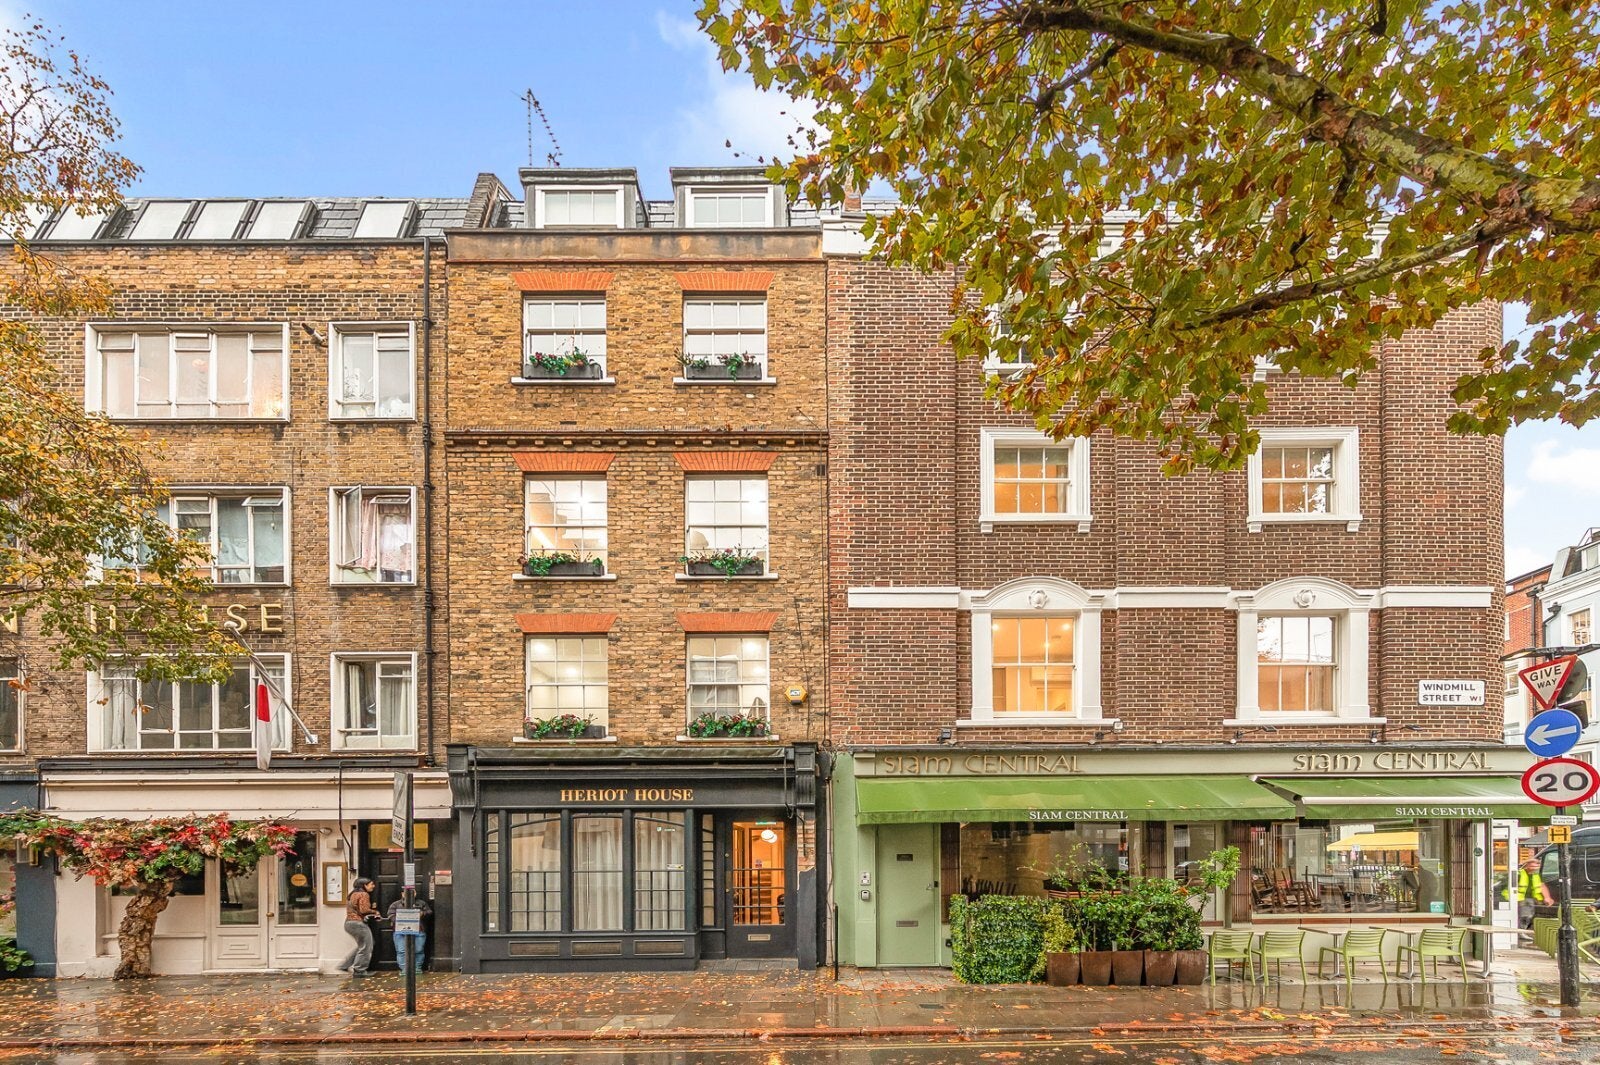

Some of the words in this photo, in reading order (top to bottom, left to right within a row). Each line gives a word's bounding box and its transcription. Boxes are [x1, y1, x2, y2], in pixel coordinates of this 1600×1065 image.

[1530, 665, 1562, 682] GIVE
[1423, 683, 1476, 691] WINDMILL
[1537, 677, 1558, 689] WAY
[1422, 694, 1462, 702] STREET
[964, 754, 1084, 773] CENTRAL
[1374, 752, 1494, 770] CENTRAL
[1534, 771, 1590, 793] 20
[560, 789, 628, 802] HERIOT
[635, 788, 694, 801] HOUSE
[1029, 810, 1063, 820] SIAM
[1065, 810, 1129, 820] CENTRAL
[1395, 807, 1429, 816] SIAM
[1431, 807, 1494, 816] CENTRAL
